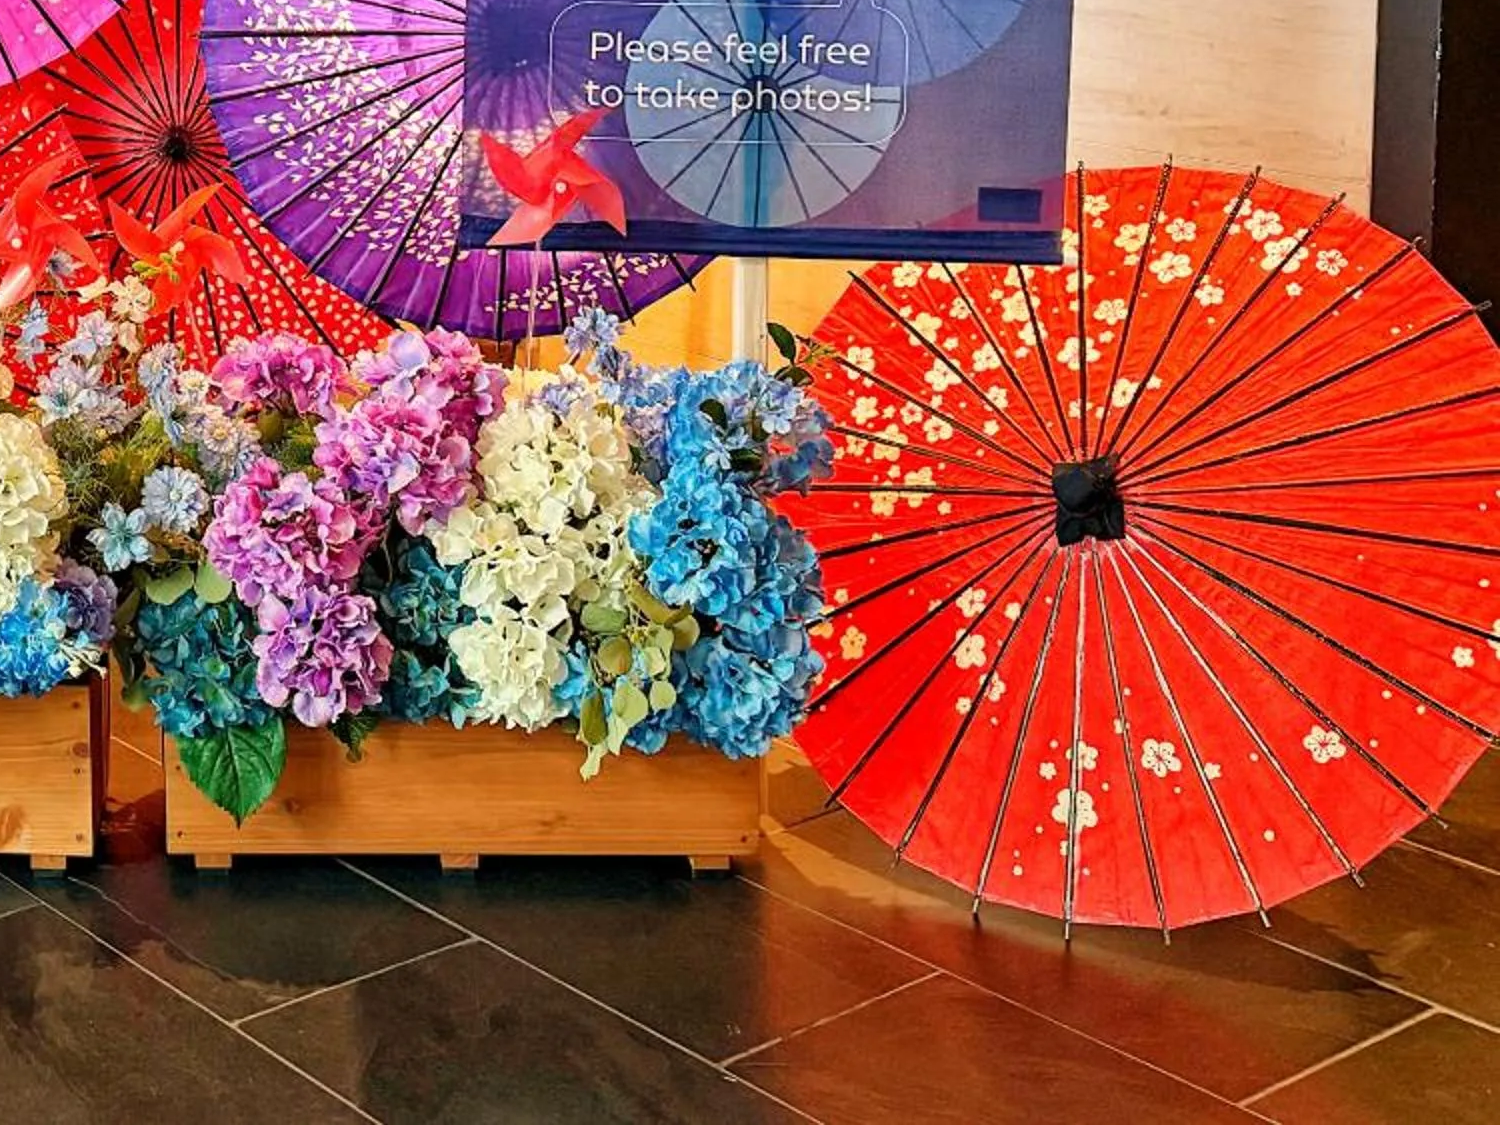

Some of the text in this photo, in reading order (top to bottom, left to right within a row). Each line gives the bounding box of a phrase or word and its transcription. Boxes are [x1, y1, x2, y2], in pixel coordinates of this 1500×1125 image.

[590, 31, 871, 65] Please feel free
[585, 80, 872, 116] to take photos!
